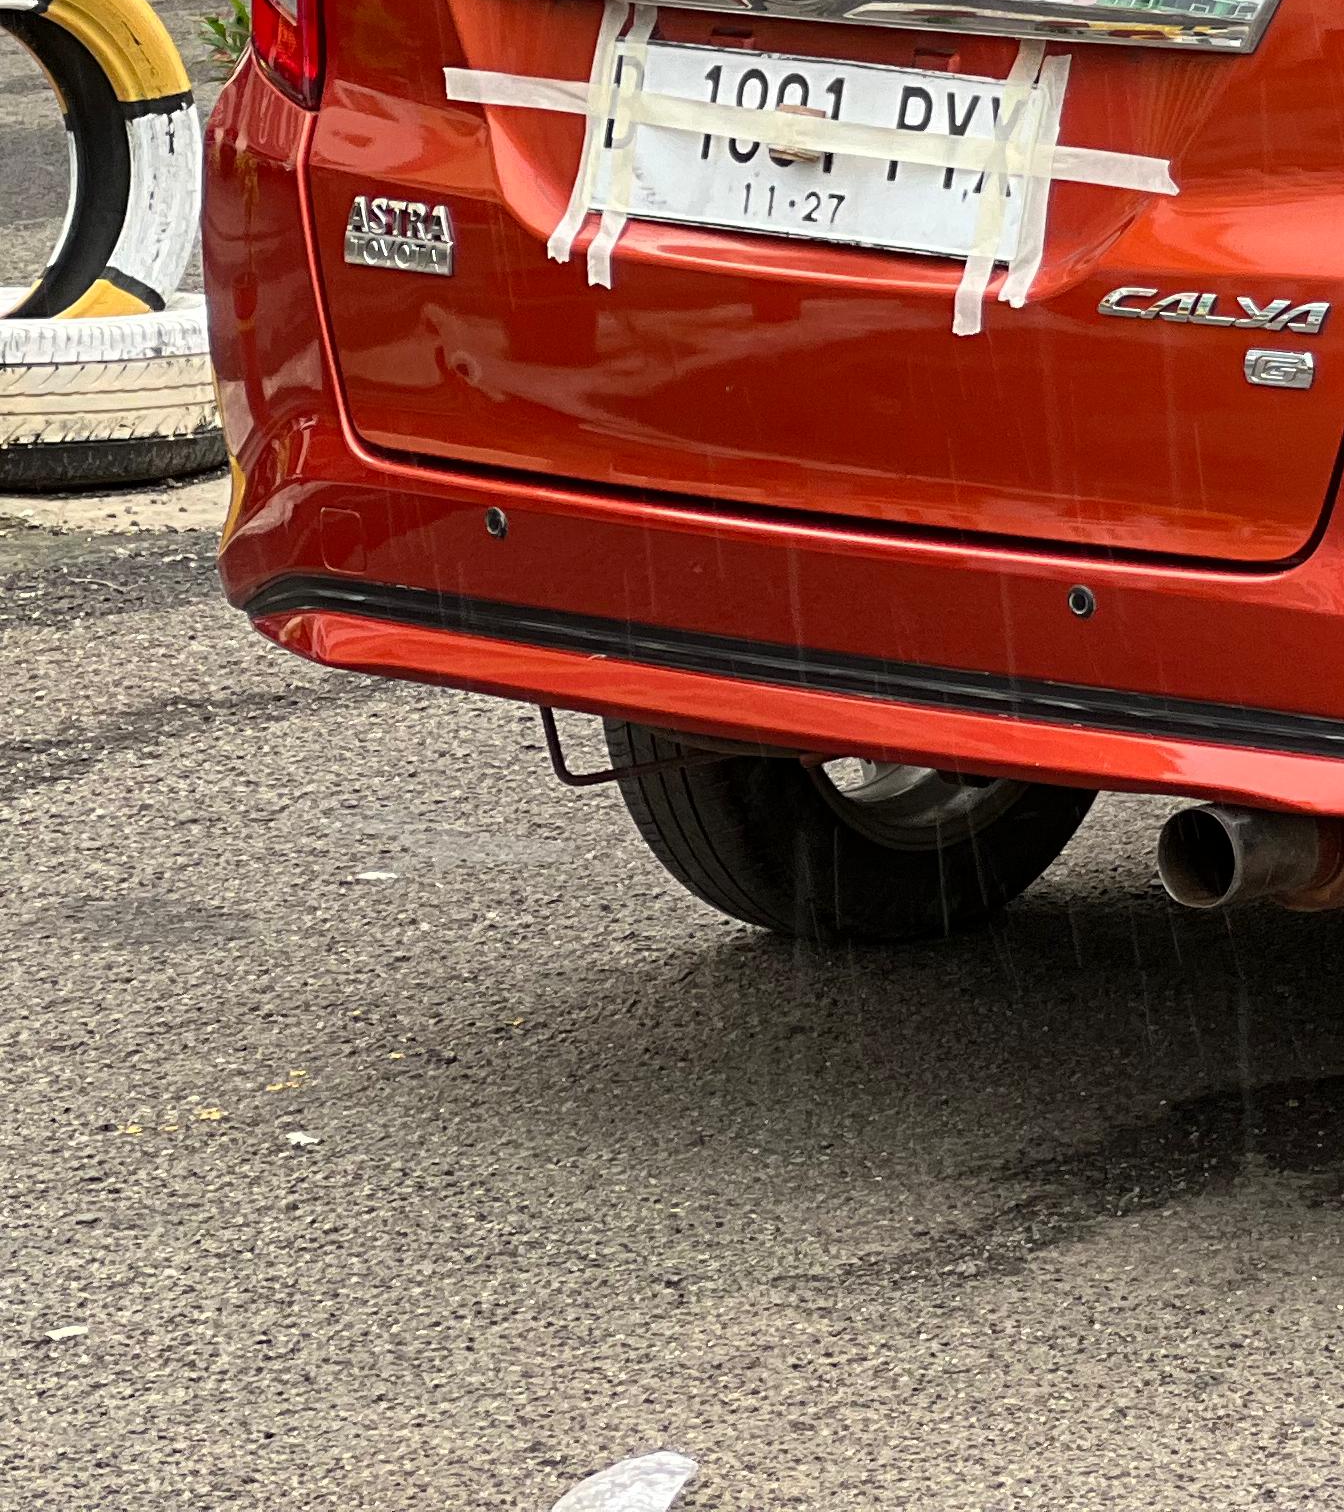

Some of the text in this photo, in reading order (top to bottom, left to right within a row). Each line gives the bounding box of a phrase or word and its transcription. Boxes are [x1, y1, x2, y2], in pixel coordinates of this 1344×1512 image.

[347, 195, 454, 243] ASTRA
[349, 236, 443, 274] TOYOTA
[1097, 286, 1331, 334] CALYA
[1249, 352, 1304, 386] G
